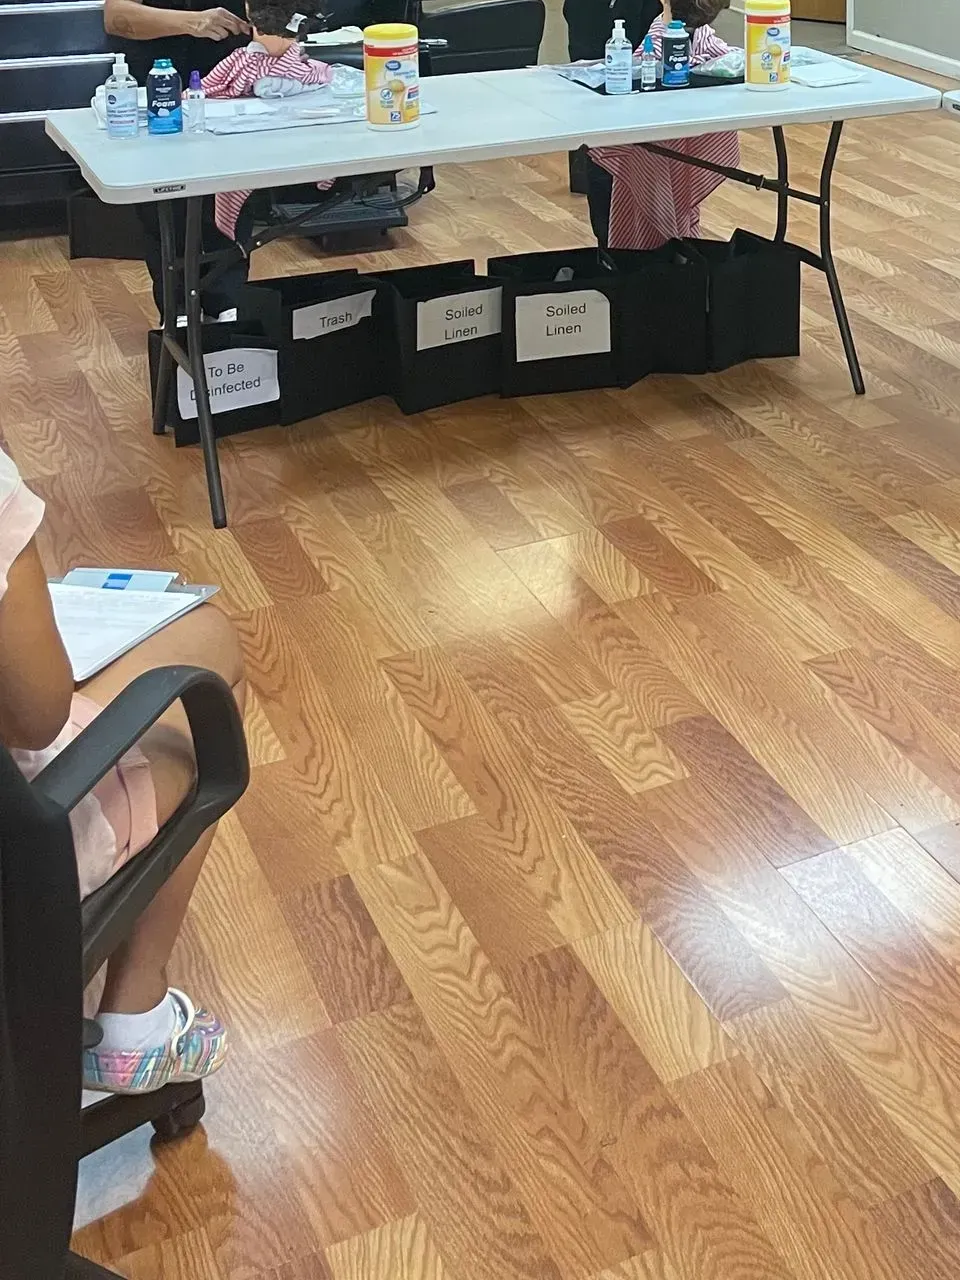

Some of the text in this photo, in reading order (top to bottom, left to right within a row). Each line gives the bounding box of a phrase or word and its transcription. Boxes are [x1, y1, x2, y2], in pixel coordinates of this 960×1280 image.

[152, 100, 176, 108] Foam
[445, 304, 483, 320] Soiled
[545, 303, 586, 317] Soiled
[320, 312, 353, 328] Trash
[444, 326, 478, 340] Linen
[546, 324, 582, 336] Linen
[208, 363, 245, 378] To Be
